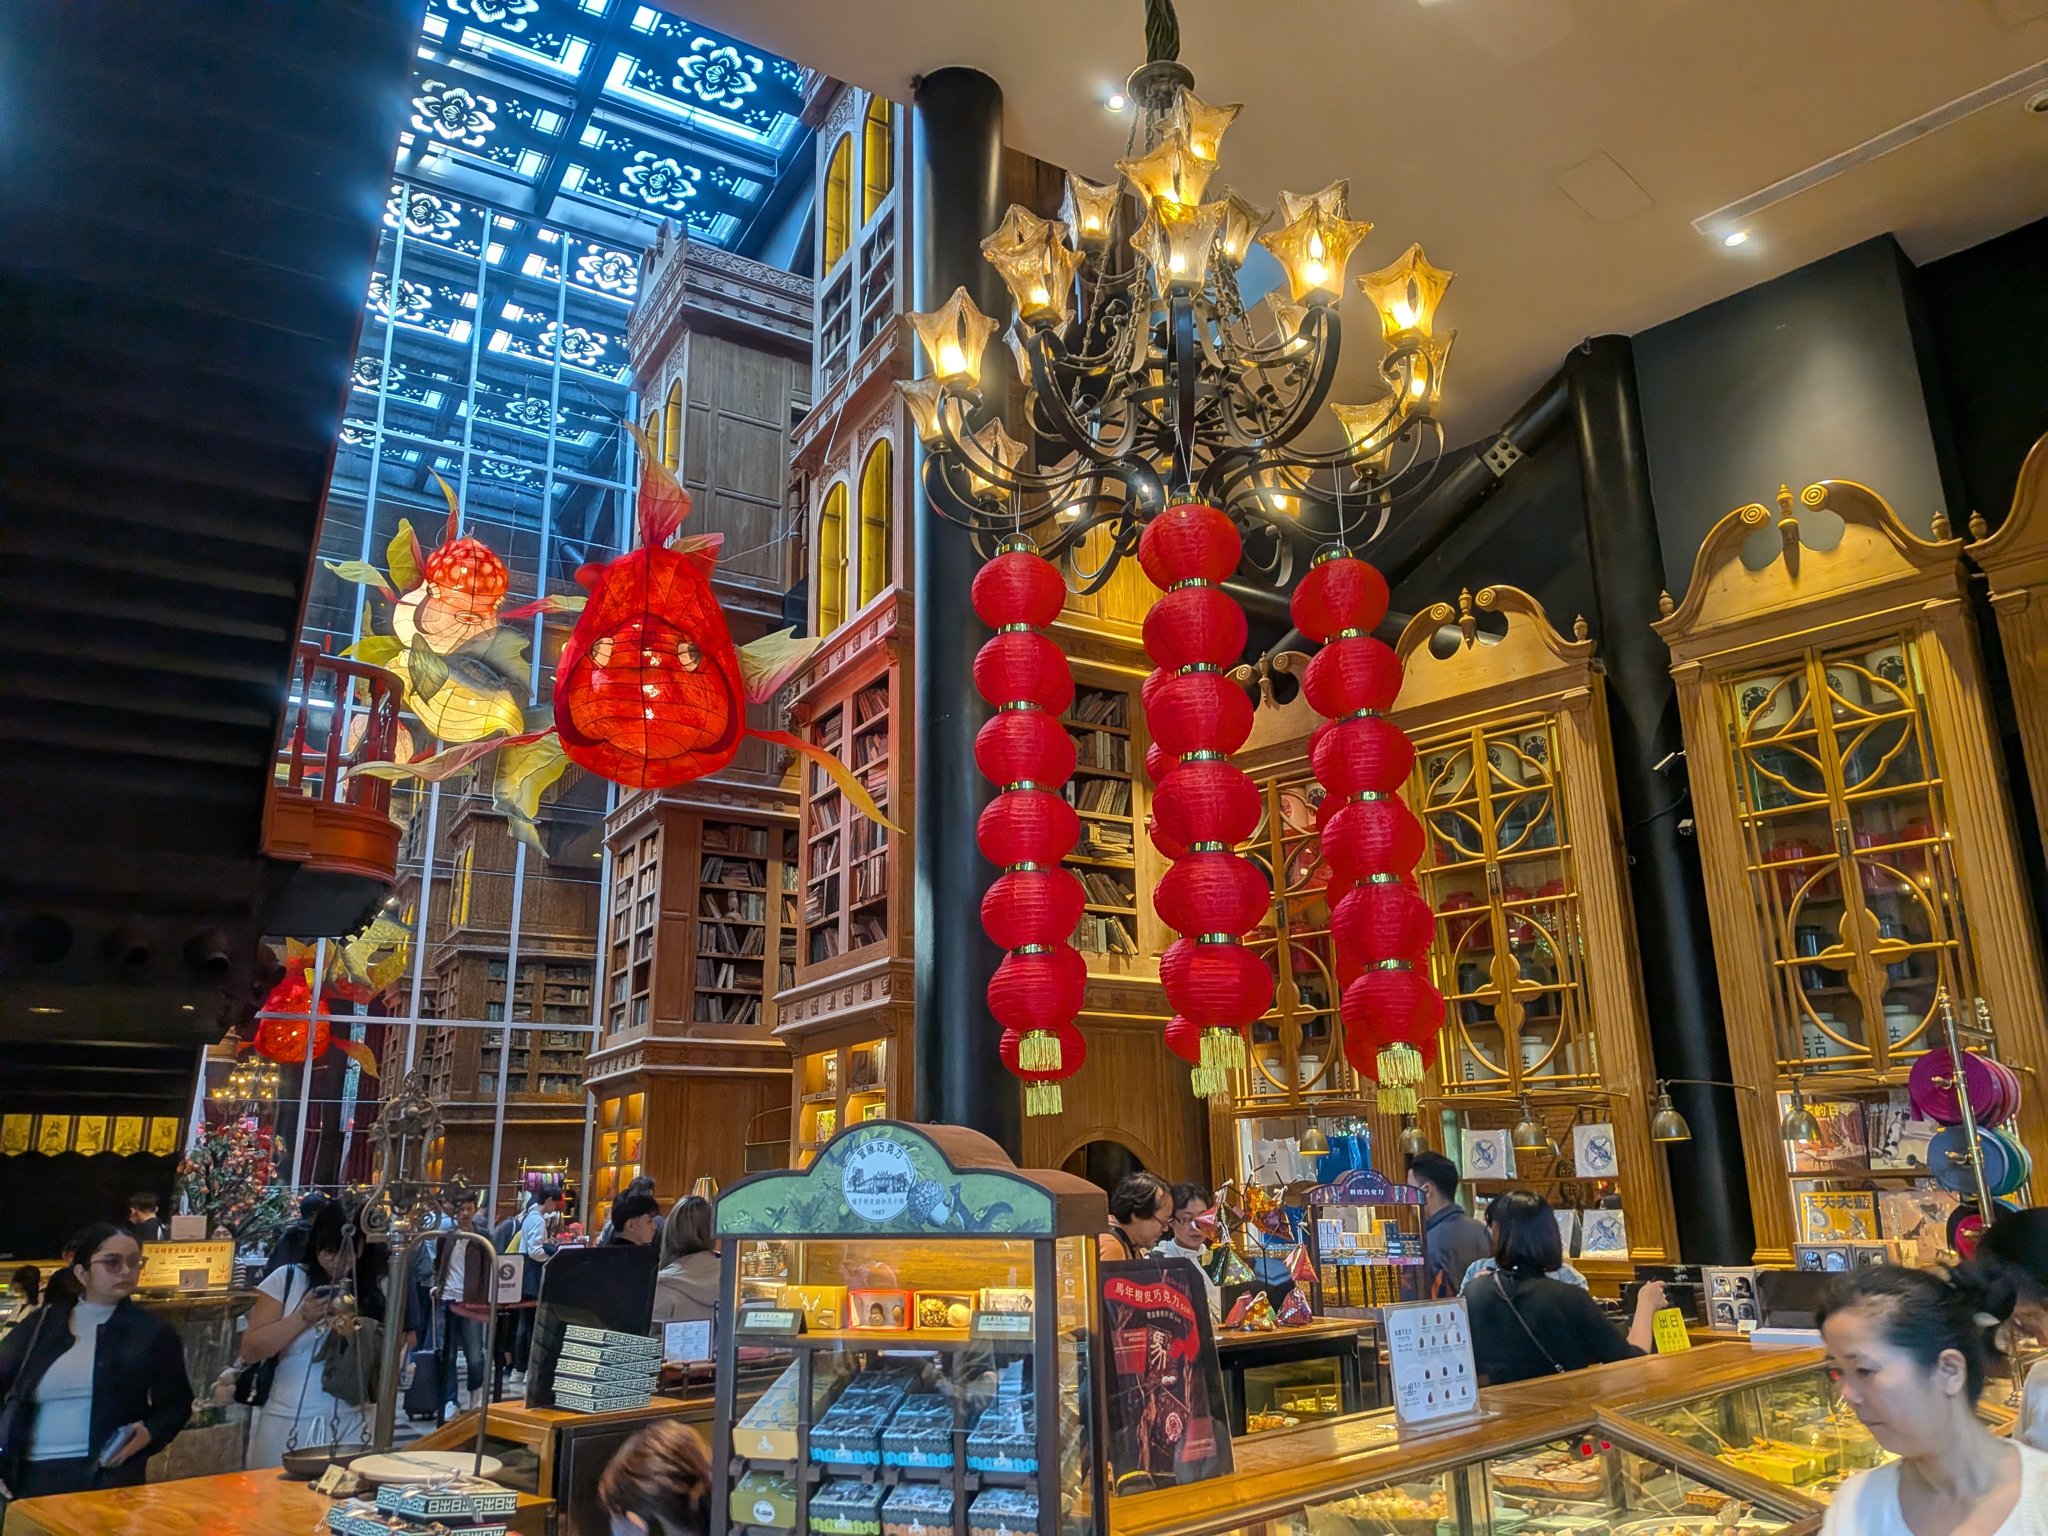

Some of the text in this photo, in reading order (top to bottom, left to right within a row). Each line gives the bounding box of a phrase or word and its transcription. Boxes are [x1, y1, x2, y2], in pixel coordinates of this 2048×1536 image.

[857, 1142, 904, 1160] 宮原巧克力
[1115, 1282, 1180, 1308] 馬年樹皮巧克力
